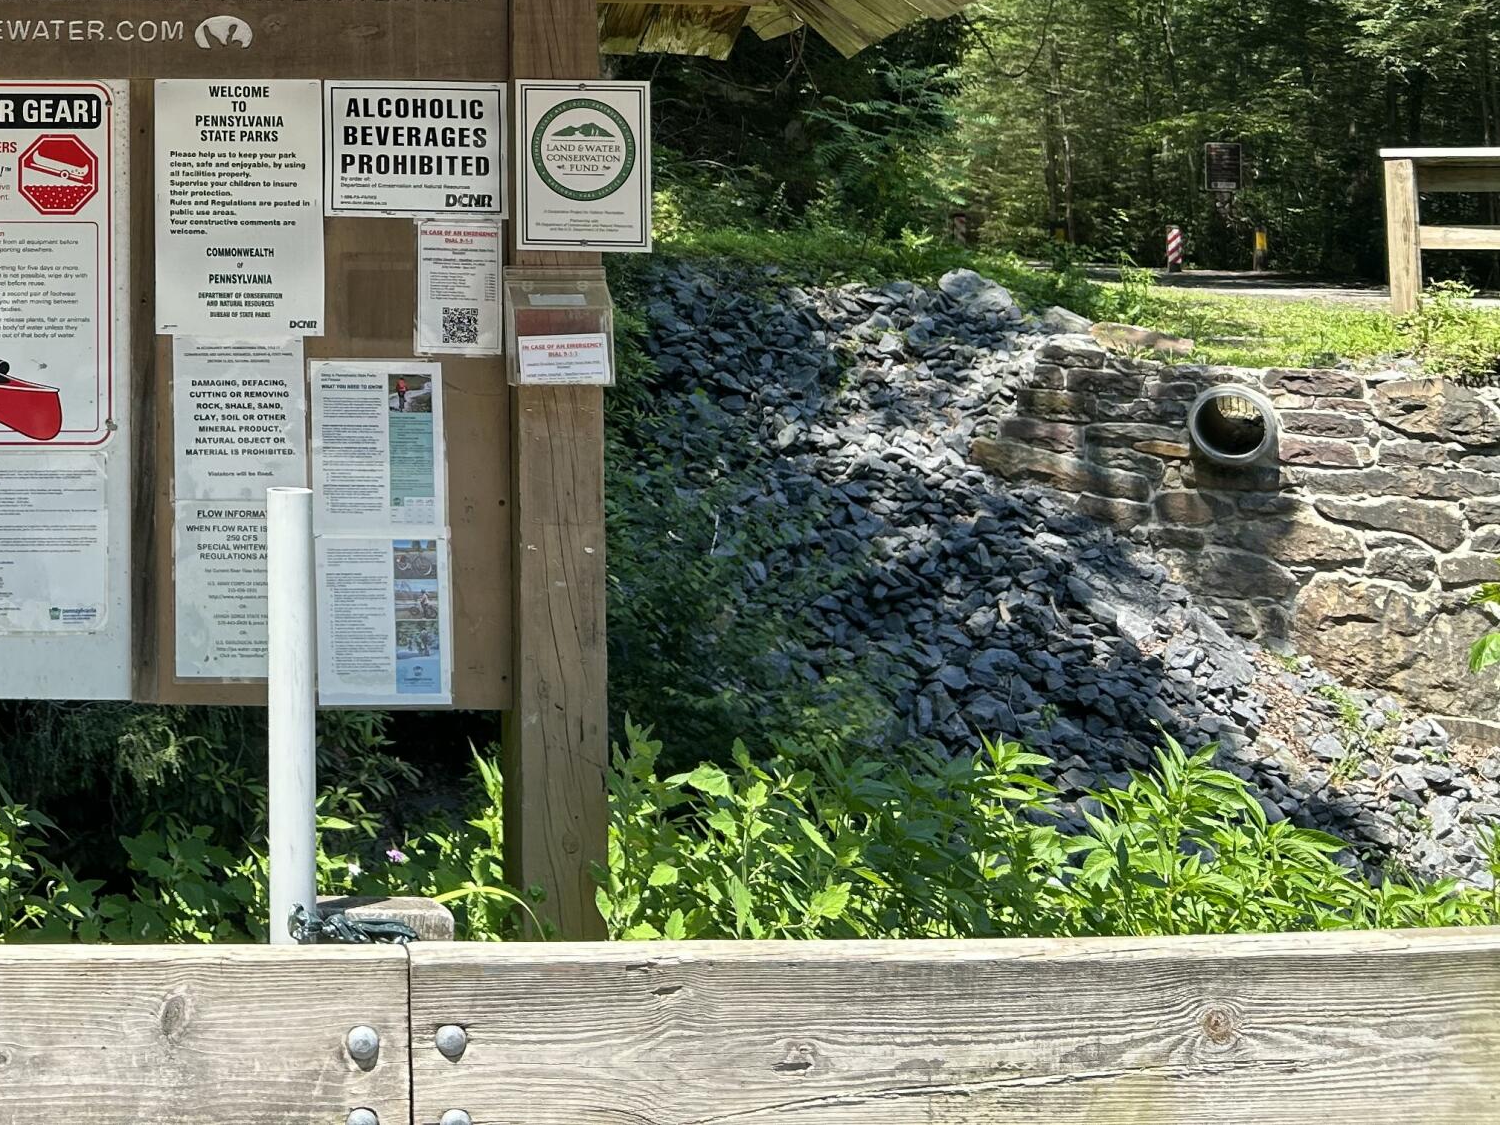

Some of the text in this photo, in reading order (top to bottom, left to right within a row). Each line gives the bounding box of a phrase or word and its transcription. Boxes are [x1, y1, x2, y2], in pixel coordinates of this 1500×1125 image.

[209, 86, 269, 97] WELCOME
[23, 100, 96, 122] GEAR!
[232, 101, 246, 112] TO
[346, 98, 483, 119] ALCOHOLIC
[196, 115, 284, 127] PENNSYLVANIA
[201, 130, 278, 142] STATE PARKS
[344, 126, 486, 148] BEVERAGES
[199, 151, 215, 159] help
[546, 154, 620, 162] CONSERVATION
[273, 161, 282, 169] by
[342, 154, 489, 177] PROHIBITED
[211, 199, 256, 207] Regulations
[446, 194, 492, 207] DCNR
[206, 248, 274, 257] COMMONWEALTH
[209, 274, 272, 284] PENNSYLVANIA
[198, 510, 267, 518] FLOW INFORMA
